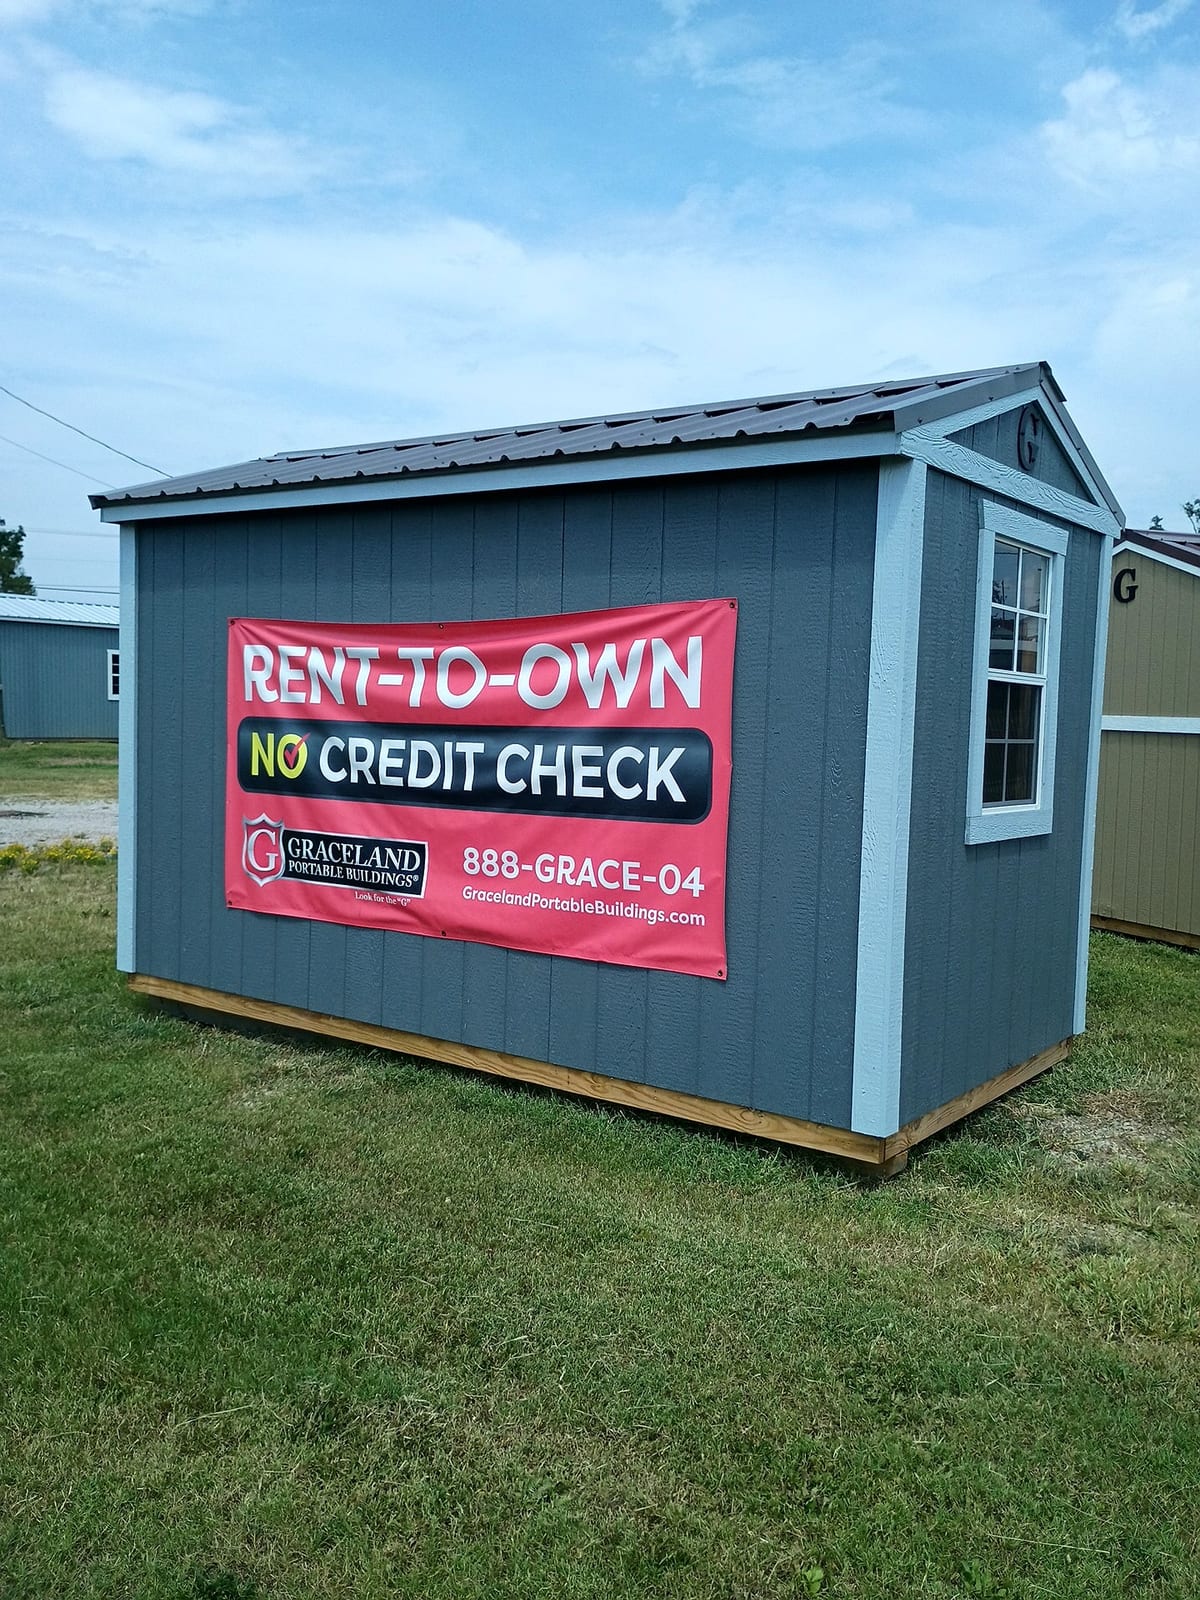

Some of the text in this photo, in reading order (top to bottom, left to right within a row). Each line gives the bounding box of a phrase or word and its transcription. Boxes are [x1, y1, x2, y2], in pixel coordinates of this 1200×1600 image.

[1113, 568, 1138, 603] G
[242, 635, 703, 710] RENT-TO-OWN
[250, 731, 686, 803] NO CREDIT CHECK
[247, 829, 278, 872] G
[287, 837, 421, 872] GRACELAND
[288, 859, 344, 879] PORTABLE
[462, 847, 705, 898] 888-GRACE-04
[355, 891, 373, 902] Look
[373, 894, 385, 903] for
[385, 895, 397, 905] the
[462, 885, 706, 927] GracelandPortableBuildings.com
